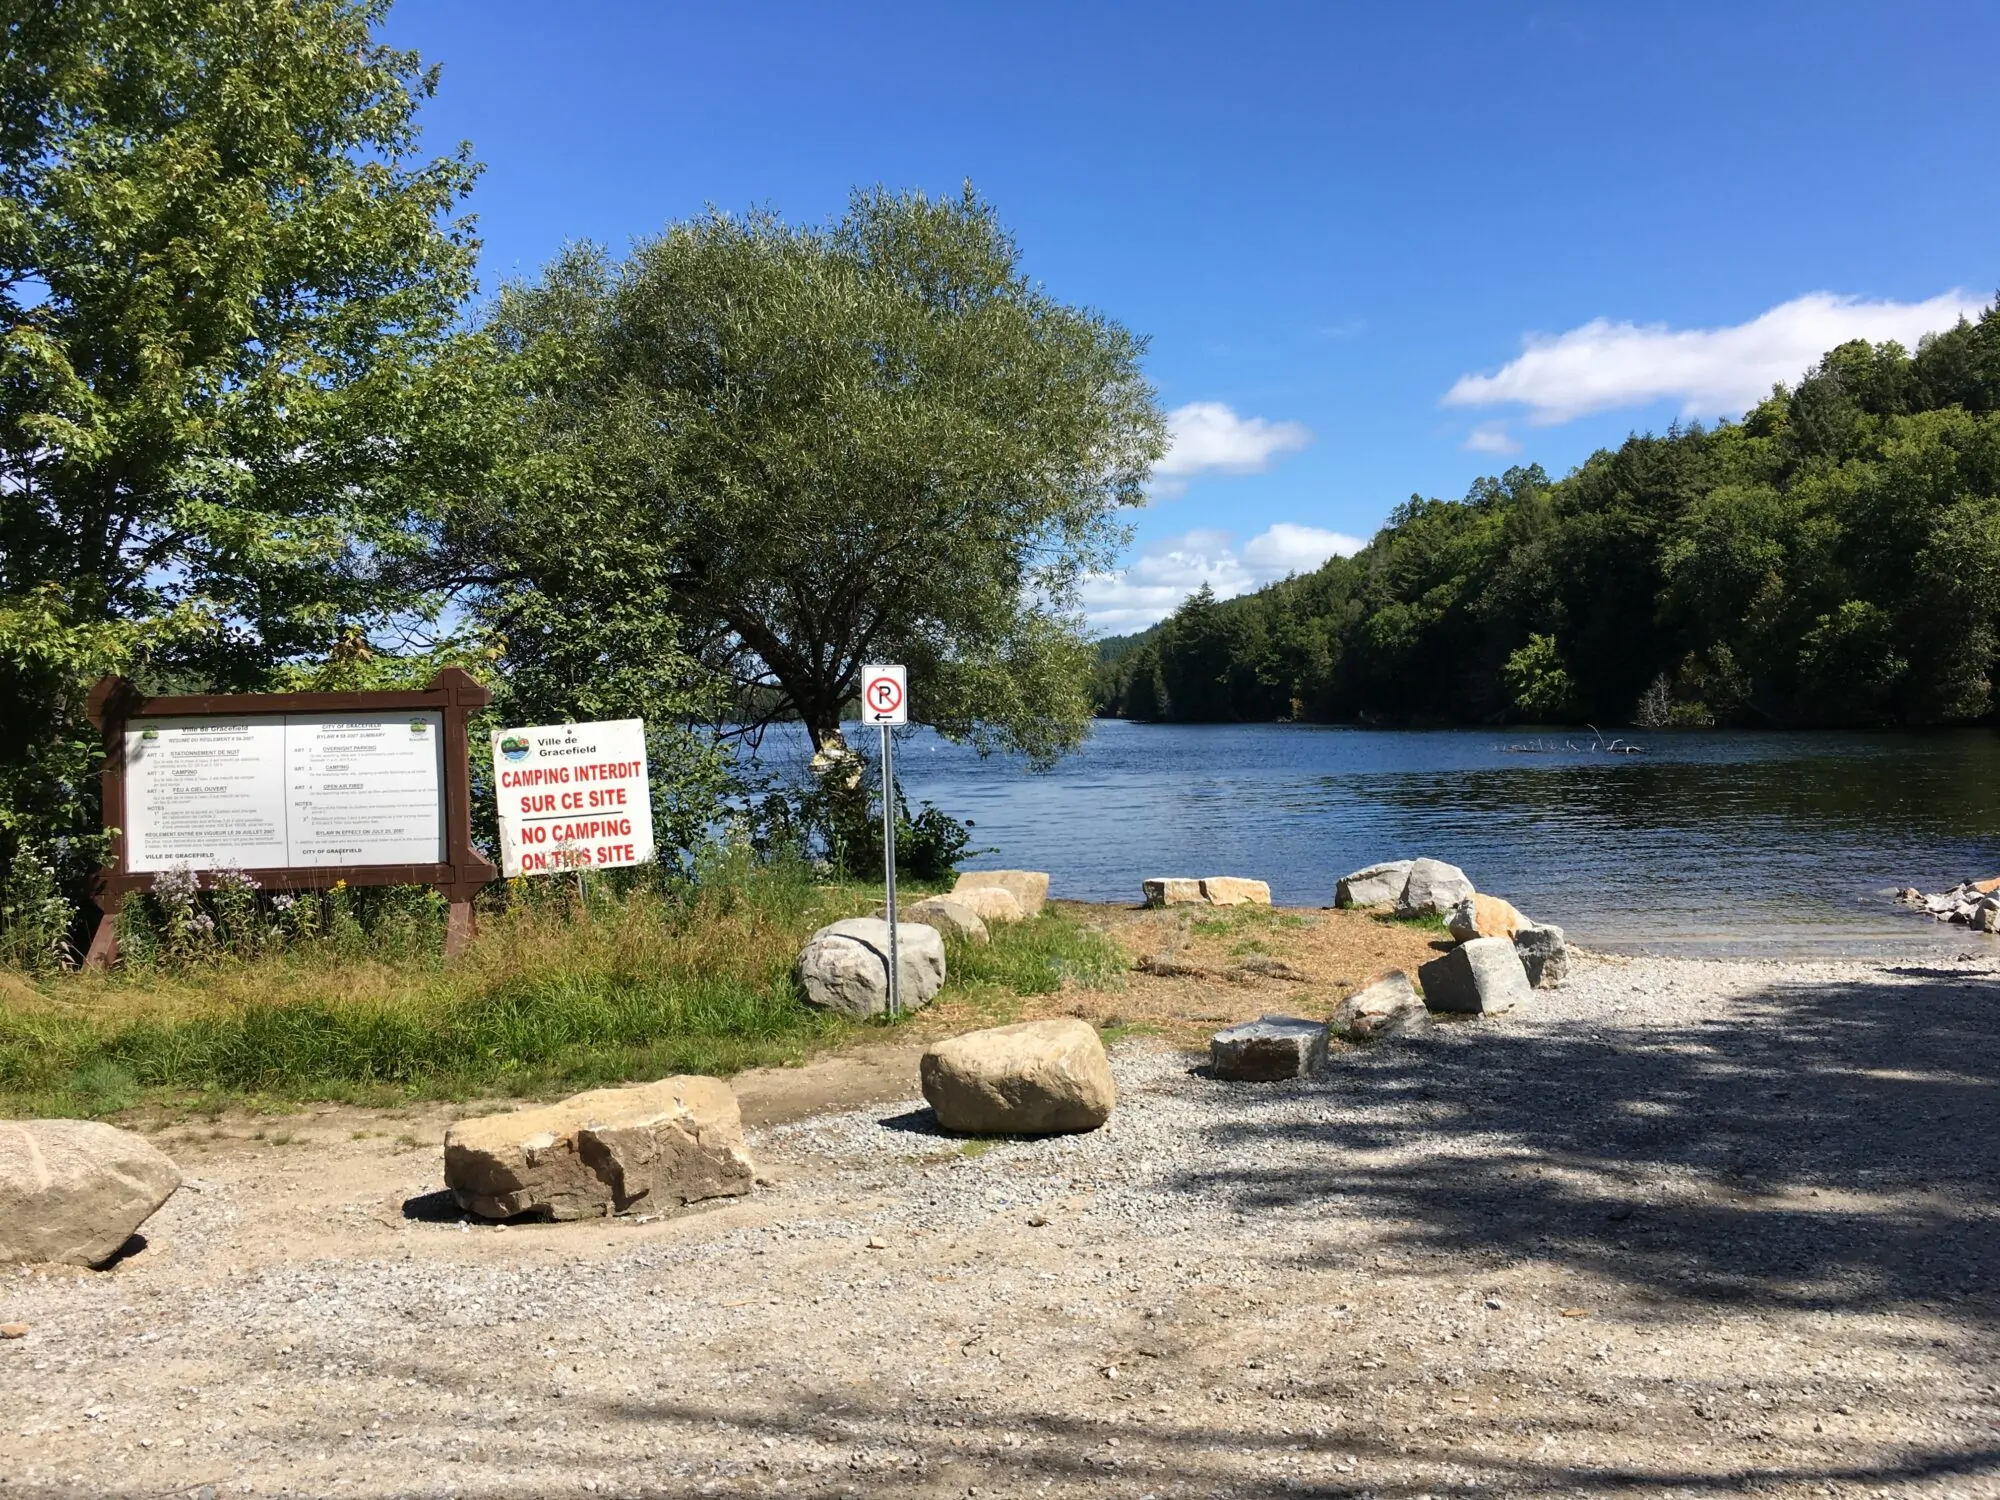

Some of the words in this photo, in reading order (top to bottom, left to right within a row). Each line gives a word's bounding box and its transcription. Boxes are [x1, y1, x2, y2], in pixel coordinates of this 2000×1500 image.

[879, 685, 891, 704] P
[537, 738, 561, 746] Ville
[564, 737, 578, 745] de
[539, 745, 597, 757] Gracefield
[501, 767, 570, 788] CAMPING
[574, 761, 641, 782] INTERDIT
[520, 794, 556, 813] SUR
[561, 792, 584, 810] CE
[589, 788, 627, 807] SITE
[521, 826, 547, 845] NO
[552, 818, 632, 841] CAMPING
[521, 853, 546, 871] ON
[597, 844, 635, 864] SITE
